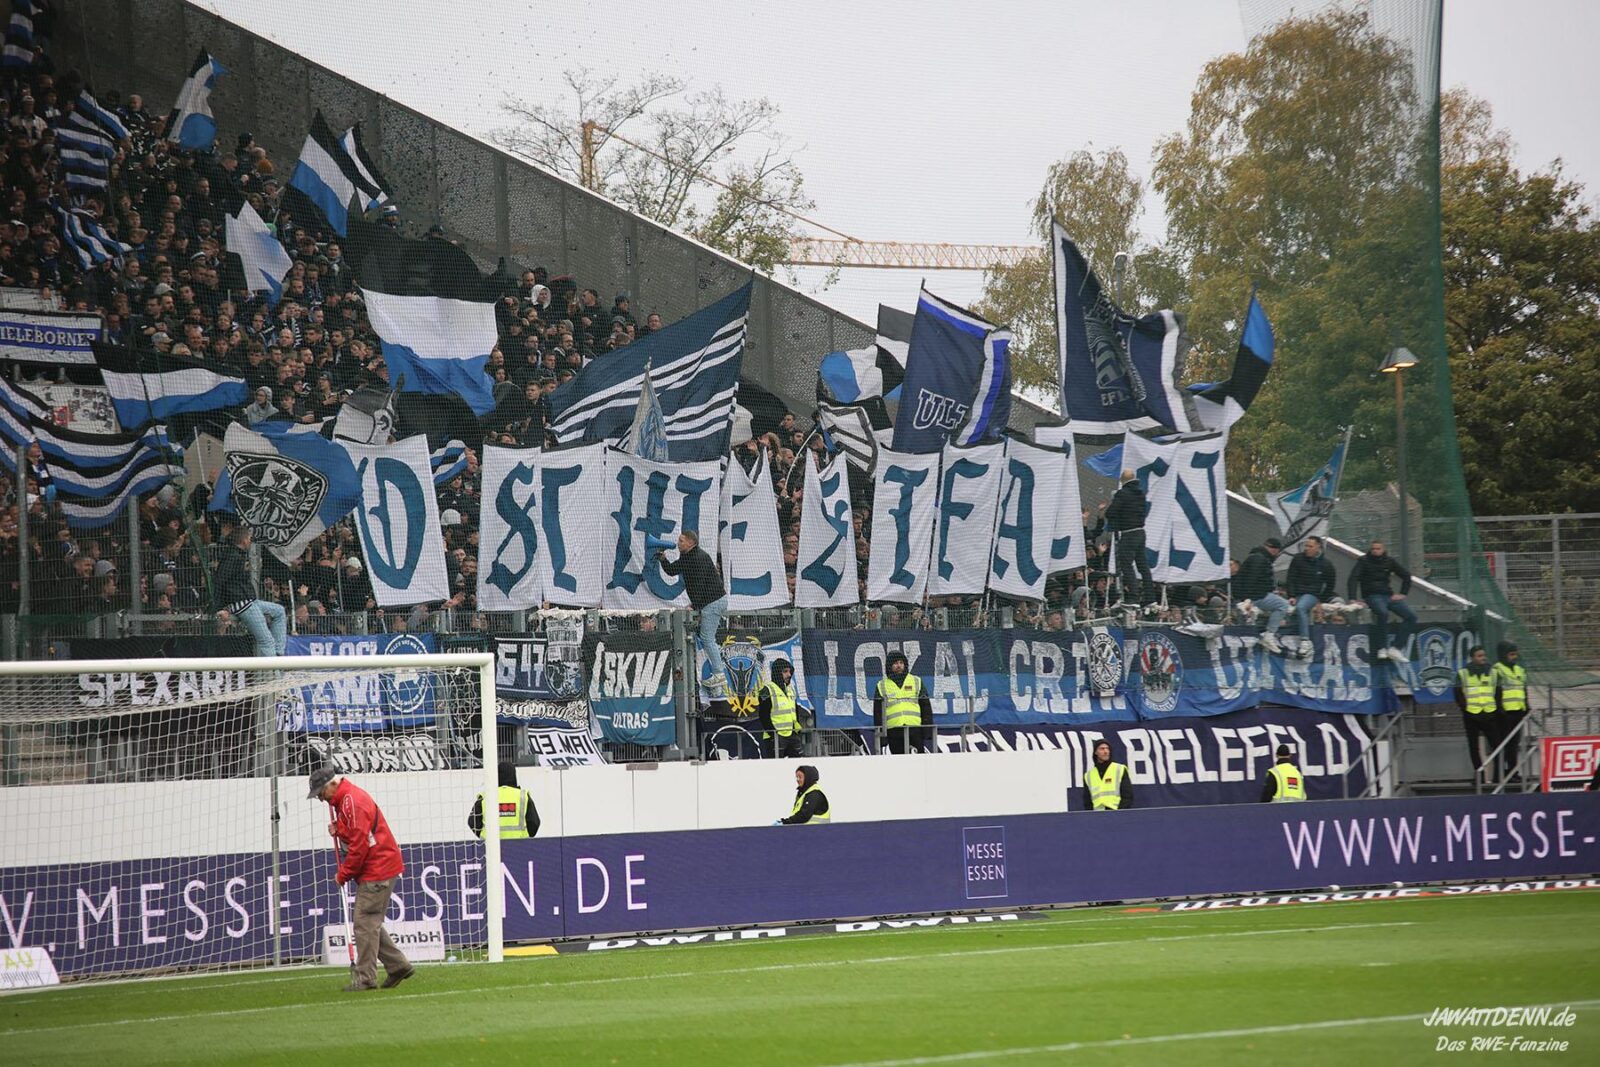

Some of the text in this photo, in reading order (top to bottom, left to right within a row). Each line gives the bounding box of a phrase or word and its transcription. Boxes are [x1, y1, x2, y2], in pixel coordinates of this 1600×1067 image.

[496, 642, 546, 687] 647
[612, 711, 649, 729] ULTRAS
[967, 841, 1004, 860] MESSE
[967, 864, 1005, 882] ESSEN
